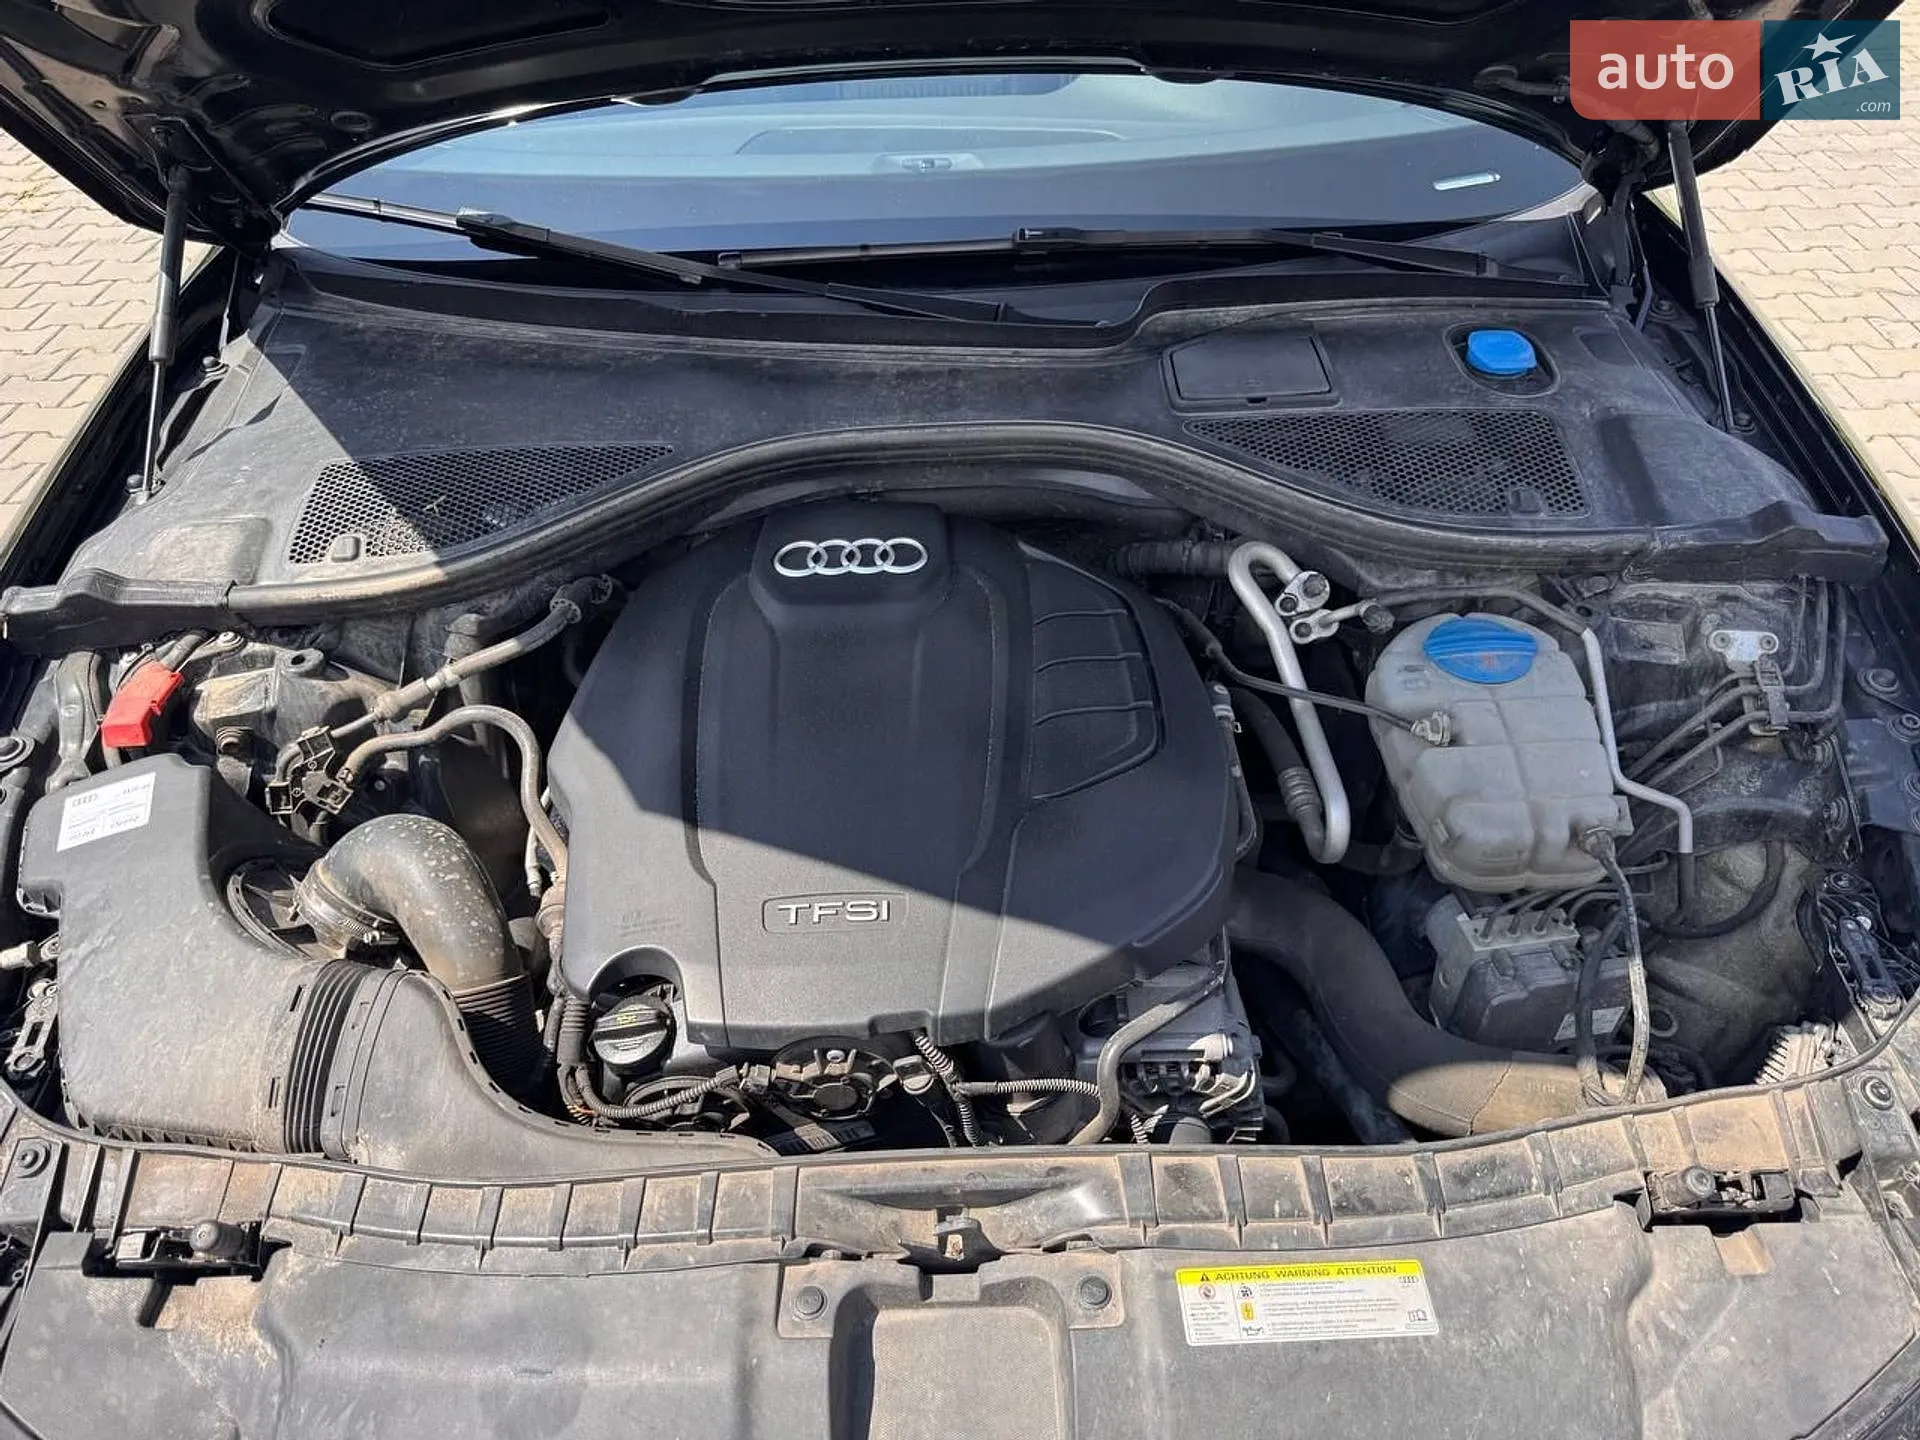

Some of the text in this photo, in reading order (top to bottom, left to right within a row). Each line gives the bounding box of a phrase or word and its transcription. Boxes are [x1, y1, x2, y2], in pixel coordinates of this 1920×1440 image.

[778, 899, 891, 926] TFSI
[1215, 1265, 1397, 1282] ACHTUNG WARNING ATTENTION
